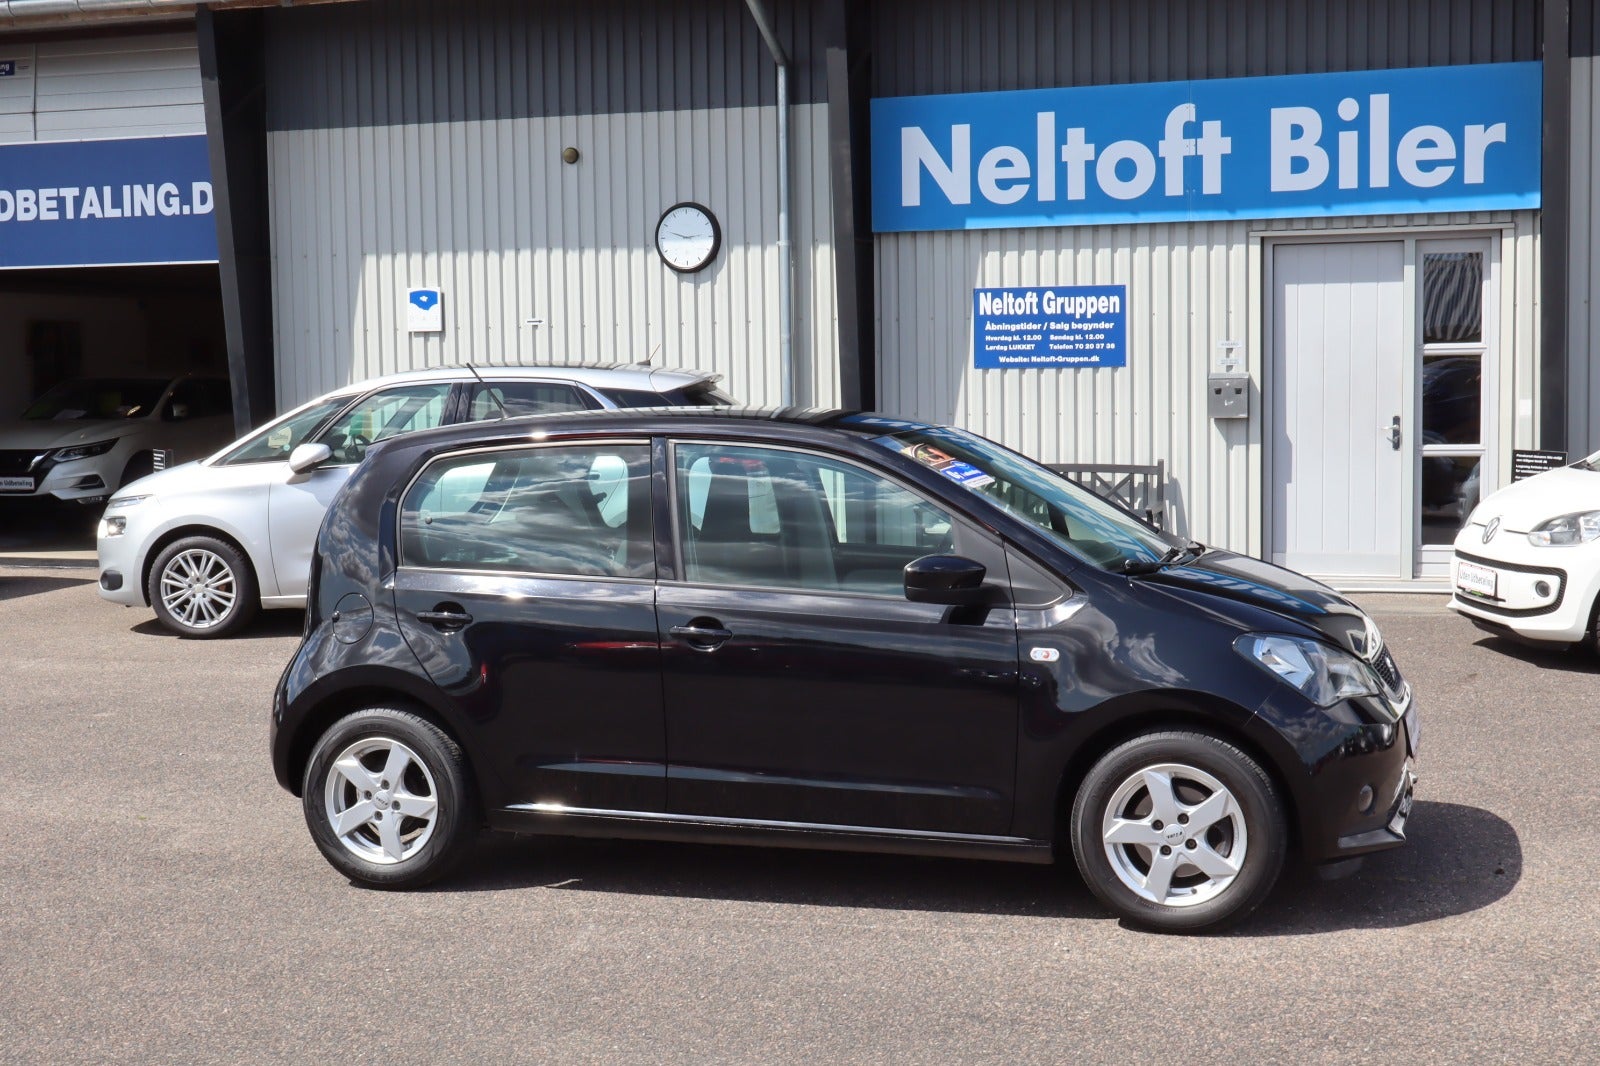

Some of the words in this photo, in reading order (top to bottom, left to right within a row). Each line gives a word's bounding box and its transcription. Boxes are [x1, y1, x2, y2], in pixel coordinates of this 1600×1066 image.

[901, 103, 1232, 208] Neltoft
[1270, 93, 1507, 193] Biler
[979, 291, 1038, 315] Neltoft
[1043, 291, 1119, 318] Gruppen
[985, 321, 1042, 332] Åbningstider
[1049, 321, 1070, 331] Salg
[1071, 321, 1114, 331] begynder
[999, 355, 1030, 363] Website:
